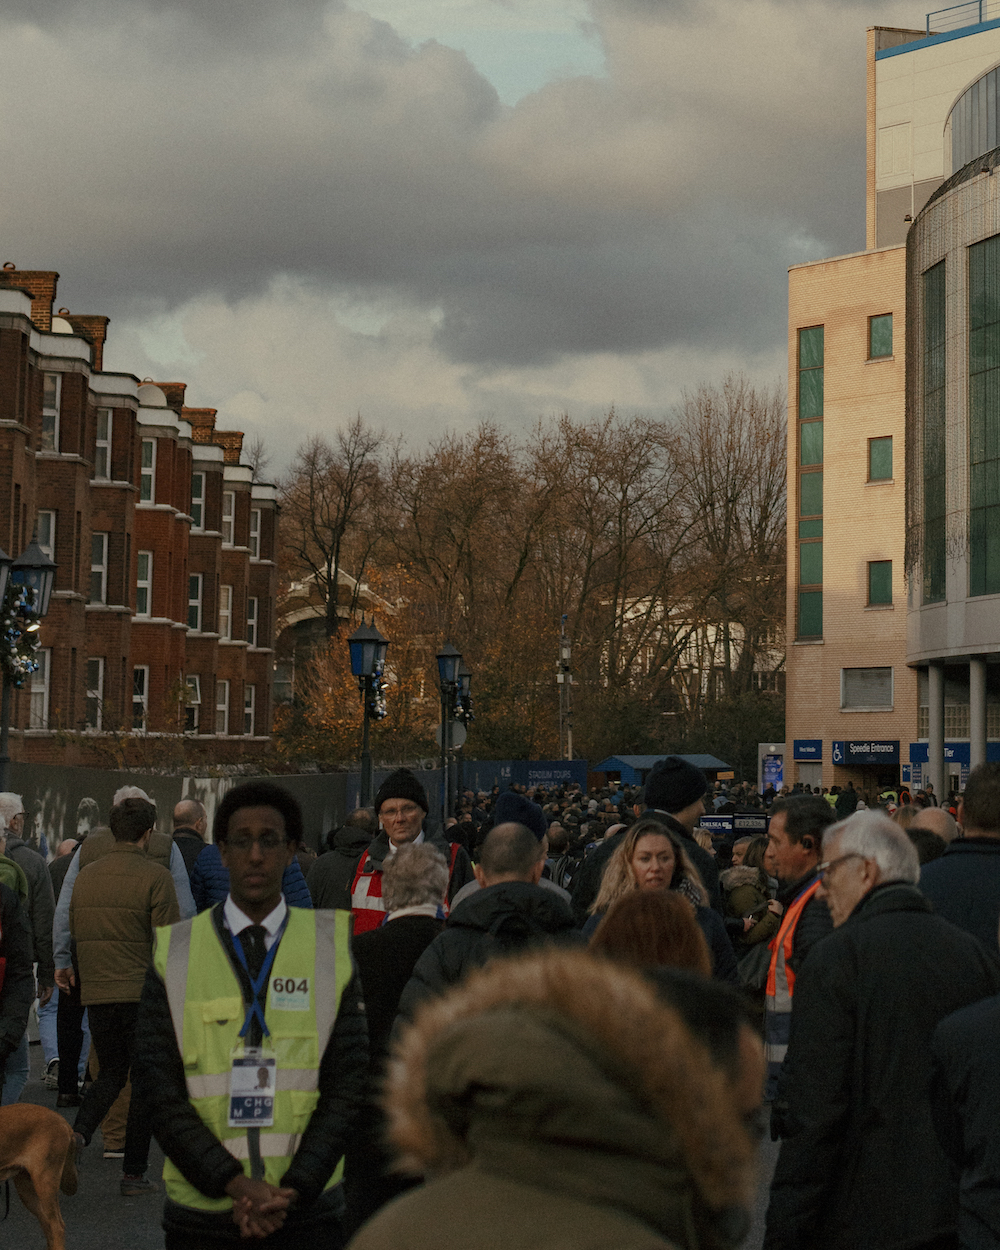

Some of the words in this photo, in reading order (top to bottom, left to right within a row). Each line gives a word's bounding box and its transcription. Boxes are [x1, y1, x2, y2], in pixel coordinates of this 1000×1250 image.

[850, 743, 870, 755] Speedie
[871, 743, 894, 753] Entrance
[528, 770, 553, 779] STADIUM
[553, 770, 571, 779] TOURS
[273, 978, 309, 995] 604
